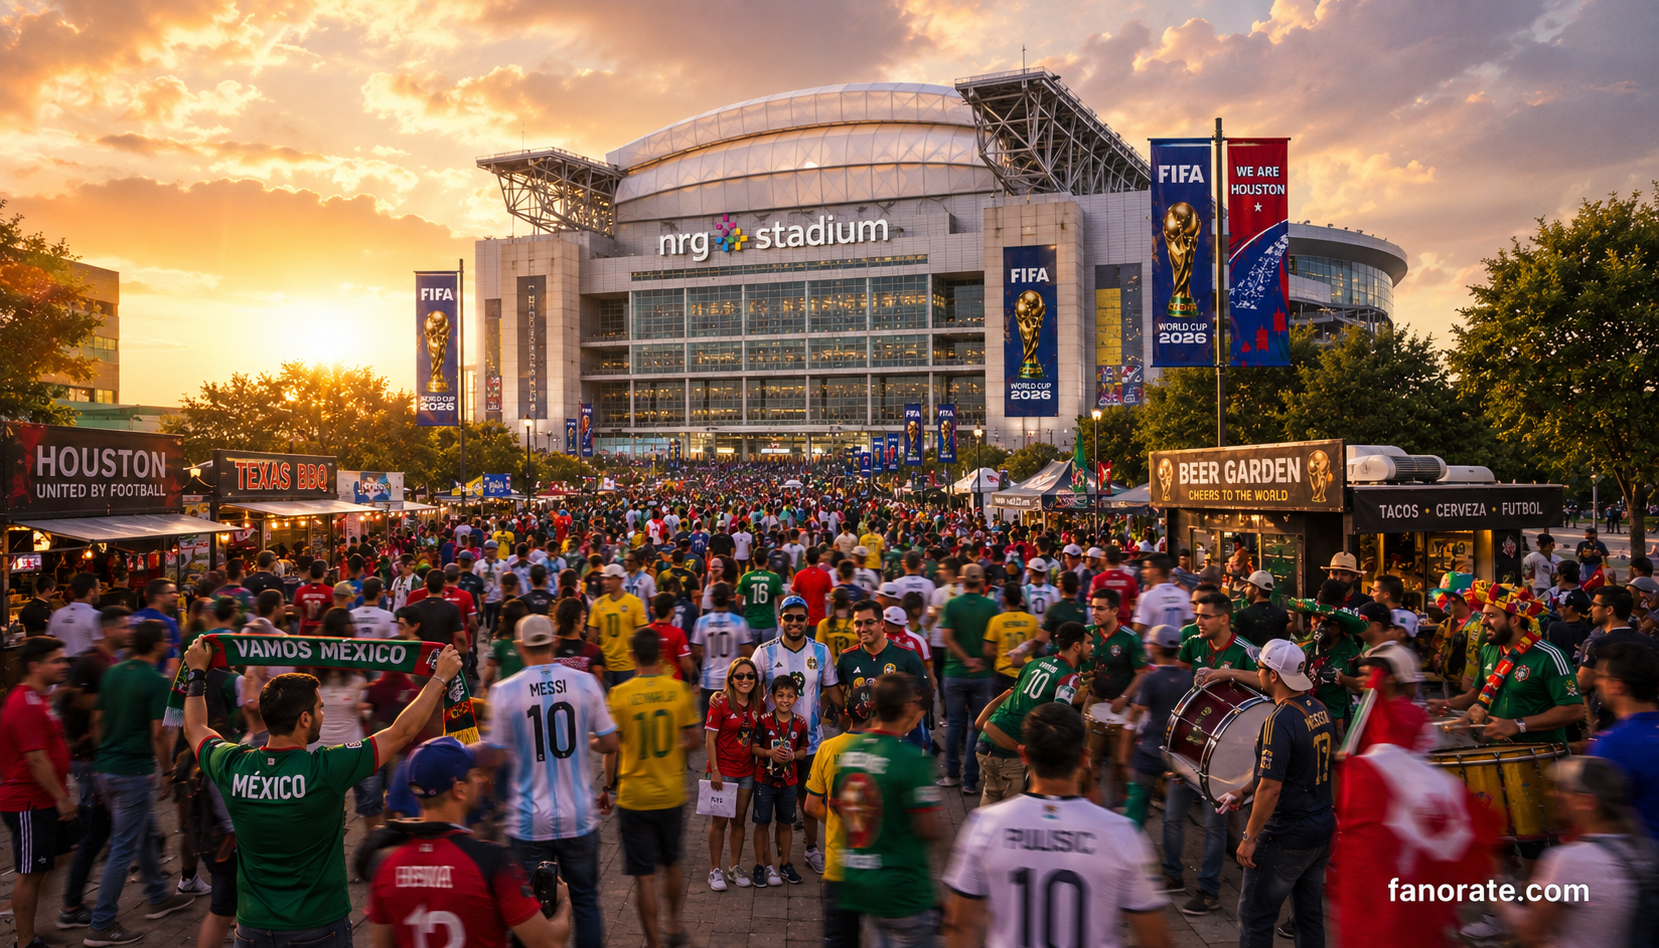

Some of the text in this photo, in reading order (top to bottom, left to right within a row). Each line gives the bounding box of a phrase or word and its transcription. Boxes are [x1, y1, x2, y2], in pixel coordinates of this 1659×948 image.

[1158, 164, 1204, 184] FIFA
[1236, 166, 1280, 177] WE ARE
[1231, 183, 1286, 196] HOUSTON
[659, 215, 889, 262] nrg stadium
[1010, 267, 1050, 283] FIFA
[420, 287, 454, 301] FIFA
[1158, 322, 1208, 332] WORLD CUP
[1158, 332, 1207, 344] 2026
[1010, 382, 1051, 391] WORLD CUP
[1010, 390, 1051, 400] 2026
[420, 402, 455, 411] 2026
[36, 445, 166, 480] HOUSTON
[1178, 456, 1301, 486] BEER GARDEN
[235, 460, 291, 491] TEXAS
[297, 461, 328, 492] BBQ
[36, 483, 166, 499] UNITED BY FOOTBALL
[1188, 489, 1288, 502] CHEERS TO THE WORLD
[1379, 501, 1543, 519] TACOS CERVEZA FUTBOL
[750, 582, 769, 604] 16
[232, 638, 407, 665] VAMOS MÉXICO
[529, 679, 567, 697] MESSI
[1023, 668, 1050, 699] 10
[527, 701, 577, 762] 10
[632, 708, 675, 760] 10
[231, 770, 306, 800] MÉXICO
[1007, 866, 1092, 948] 10
